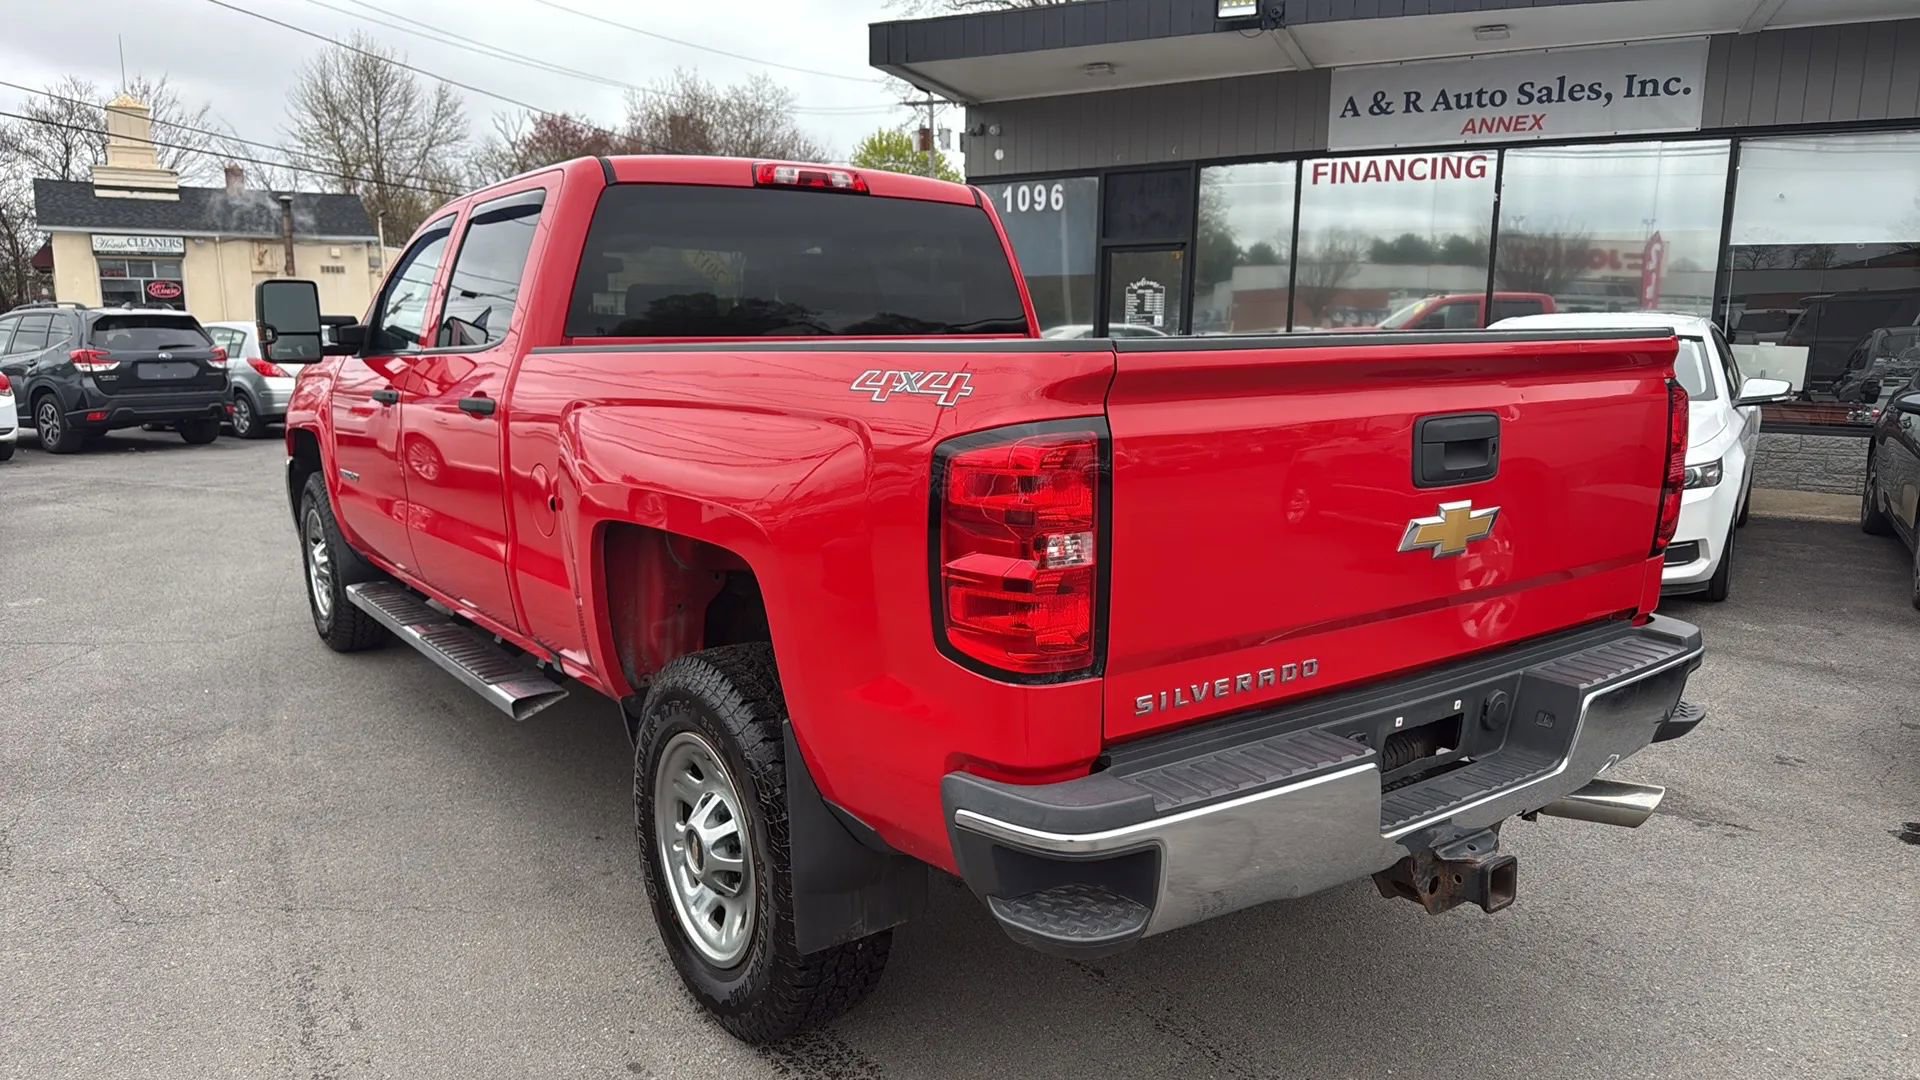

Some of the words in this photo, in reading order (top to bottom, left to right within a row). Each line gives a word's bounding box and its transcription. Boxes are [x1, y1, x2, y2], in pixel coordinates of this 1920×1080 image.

[1339, 96, 1360, 118] A
[1368, 91, 1395, 116] &
[1402, 91, 1424, 113] R
[1430, 87, 1507, 112] Auto
[1517, 76, 1613, 107] Sales,
[1623, 73, 1692, 98] Inc.
[1460, 113, 1547, 136] ANNEX
[1312, 155, 1488, 185] FINANCING
[1002, 183, 1064, 213] 1096
[127, 237, 182, 249] CLEANERS
[1135, 658, 1319, 716] SILVERADO
